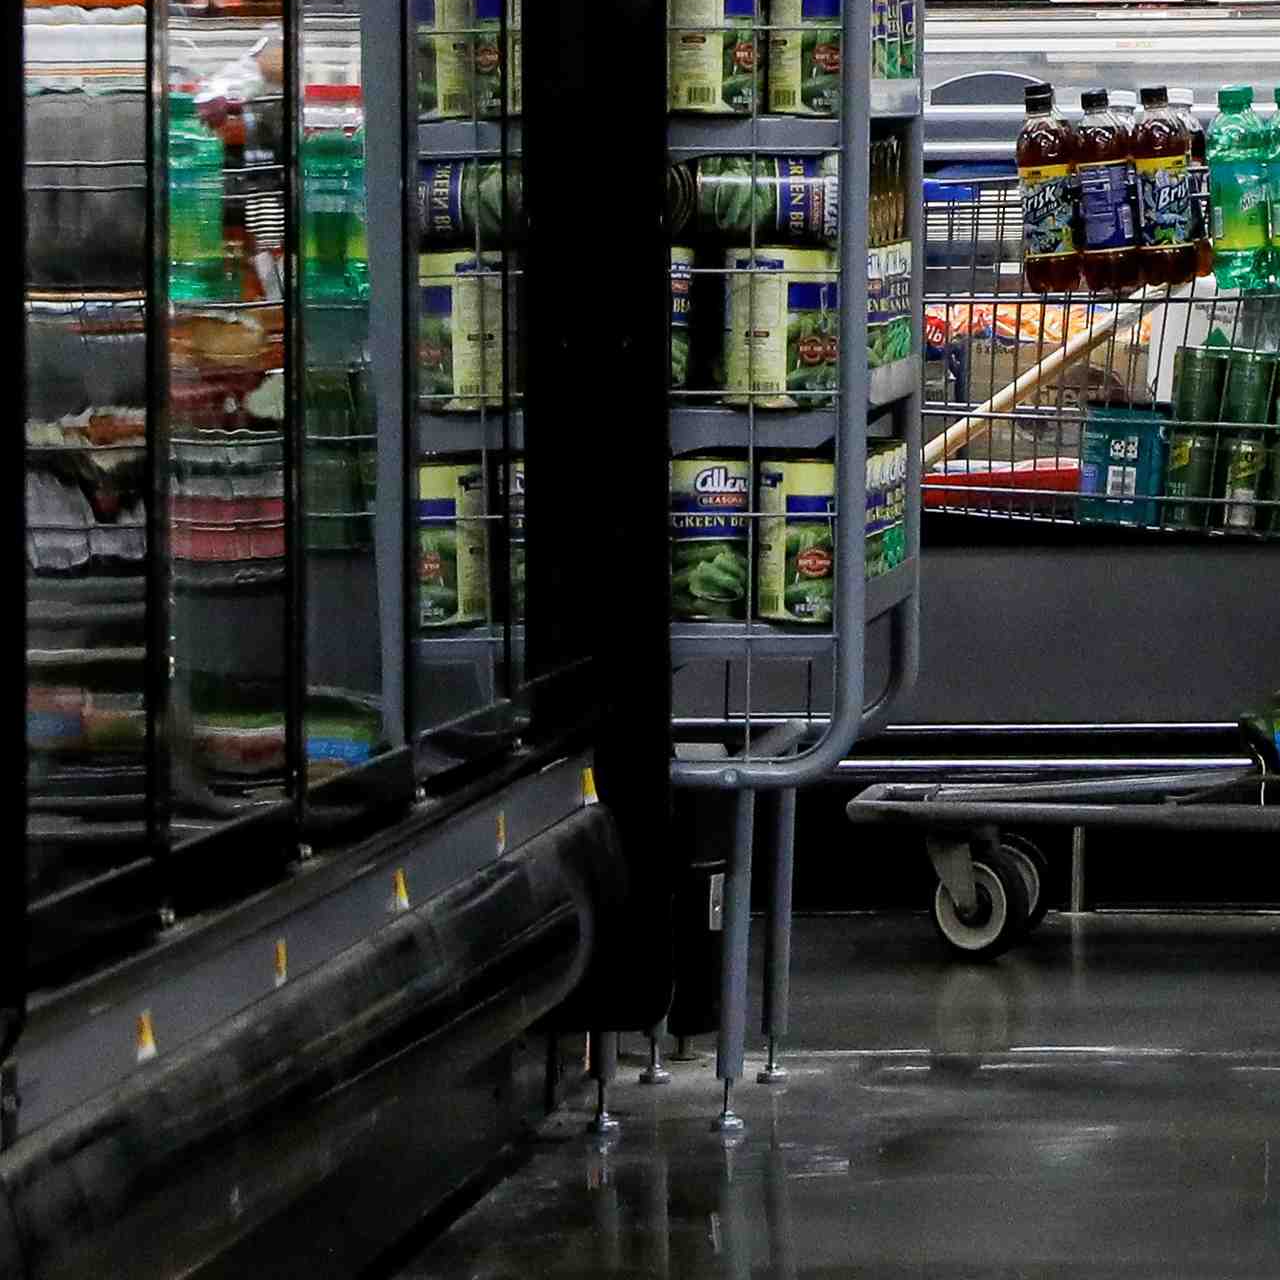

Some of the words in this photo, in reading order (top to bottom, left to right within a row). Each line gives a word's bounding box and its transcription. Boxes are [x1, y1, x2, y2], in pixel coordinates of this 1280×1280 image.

[1158, 177, 1189, 209] Bris
[696, 468, 748, 493] Allen
[702, 496, 746, 506] SEASON
